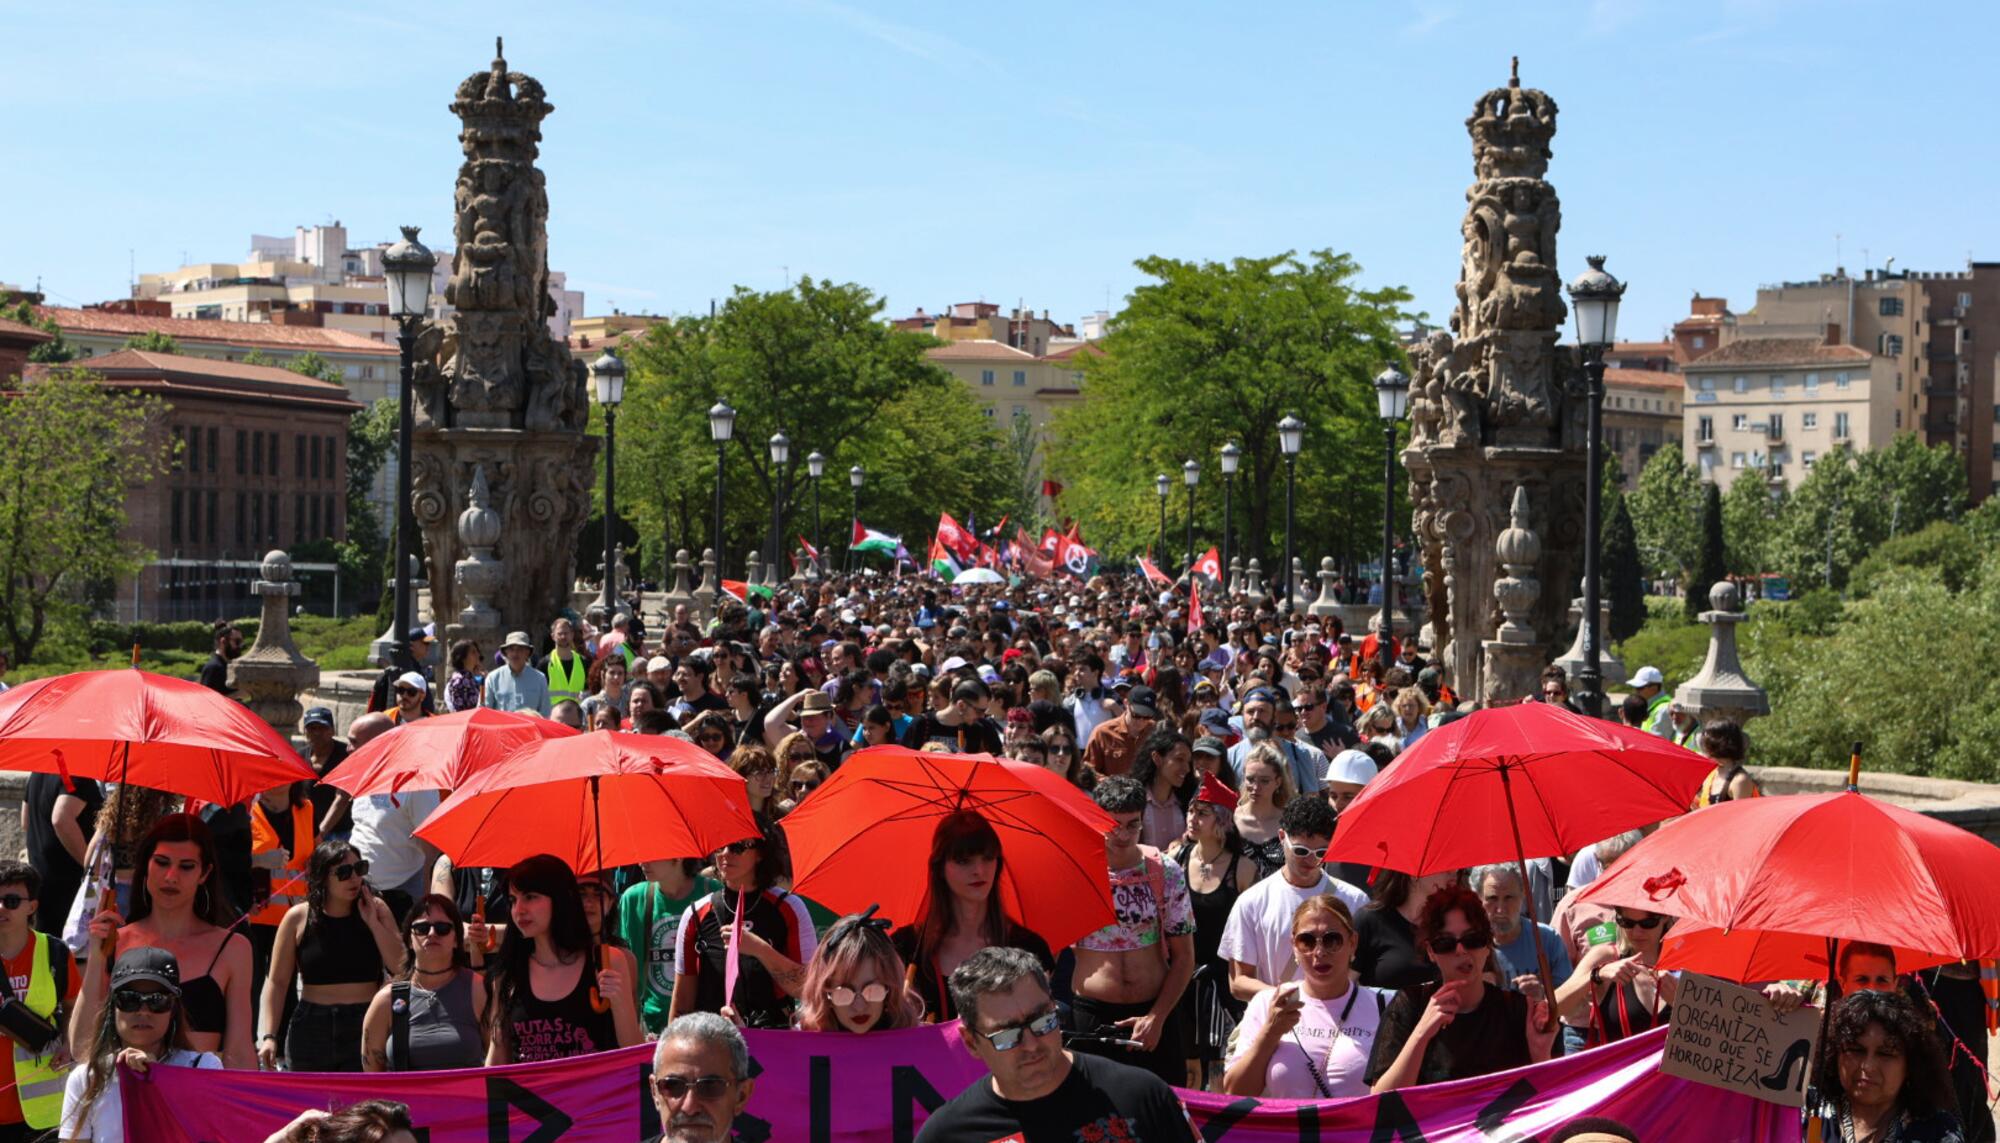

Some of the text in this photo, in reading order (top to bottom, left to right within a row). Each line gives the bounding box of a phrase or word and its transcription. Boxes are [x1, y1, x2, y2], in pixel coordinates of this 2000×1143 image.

[1681, 979, 1789, 1026] PUTA QUE SE
[513, 1017, 564, 1035] PUTAS
[519, 1032, 573, 1046] ZORRAS
[1677, 1004, 1770, 1045] ORGANIZA
[1672, 1027, 1774, 1067] ABOLO QUE SE
[1668, 1045, 1762, 1090] HORRORIZA
